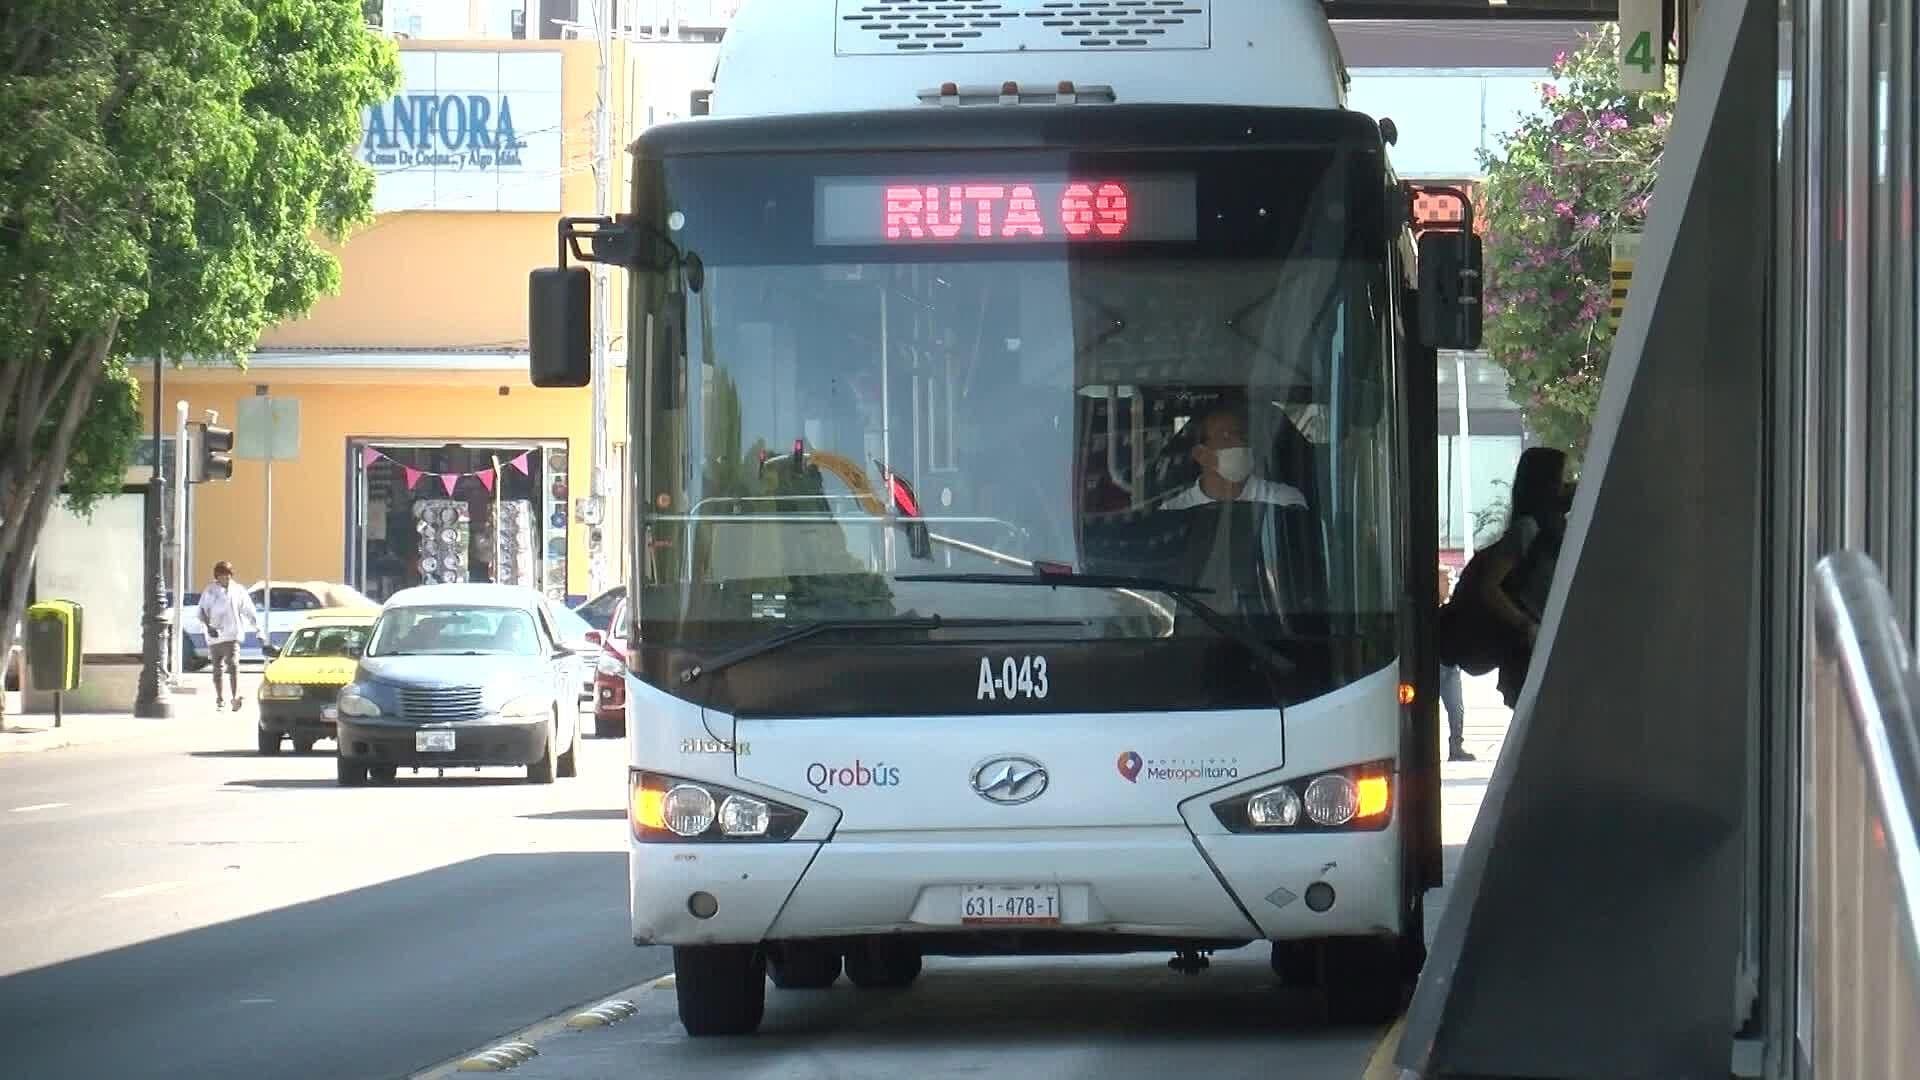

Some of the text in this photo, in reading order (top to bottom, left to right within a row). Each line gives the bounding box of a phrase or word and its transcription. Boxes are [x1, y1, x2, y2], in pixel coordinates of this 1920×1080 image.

[1625, 31, 1656, 73] 4
[468, 149, 493, 170] Algo
[886, 184, 1128, 238] RUTA 69
[977, 655, 1049, 700] A-043
[806, 760, 900, 793] Qrobús
[1147, 766, 1238, 783] Metropolitana
[966, 896, 1054, 916] 631-478-T
